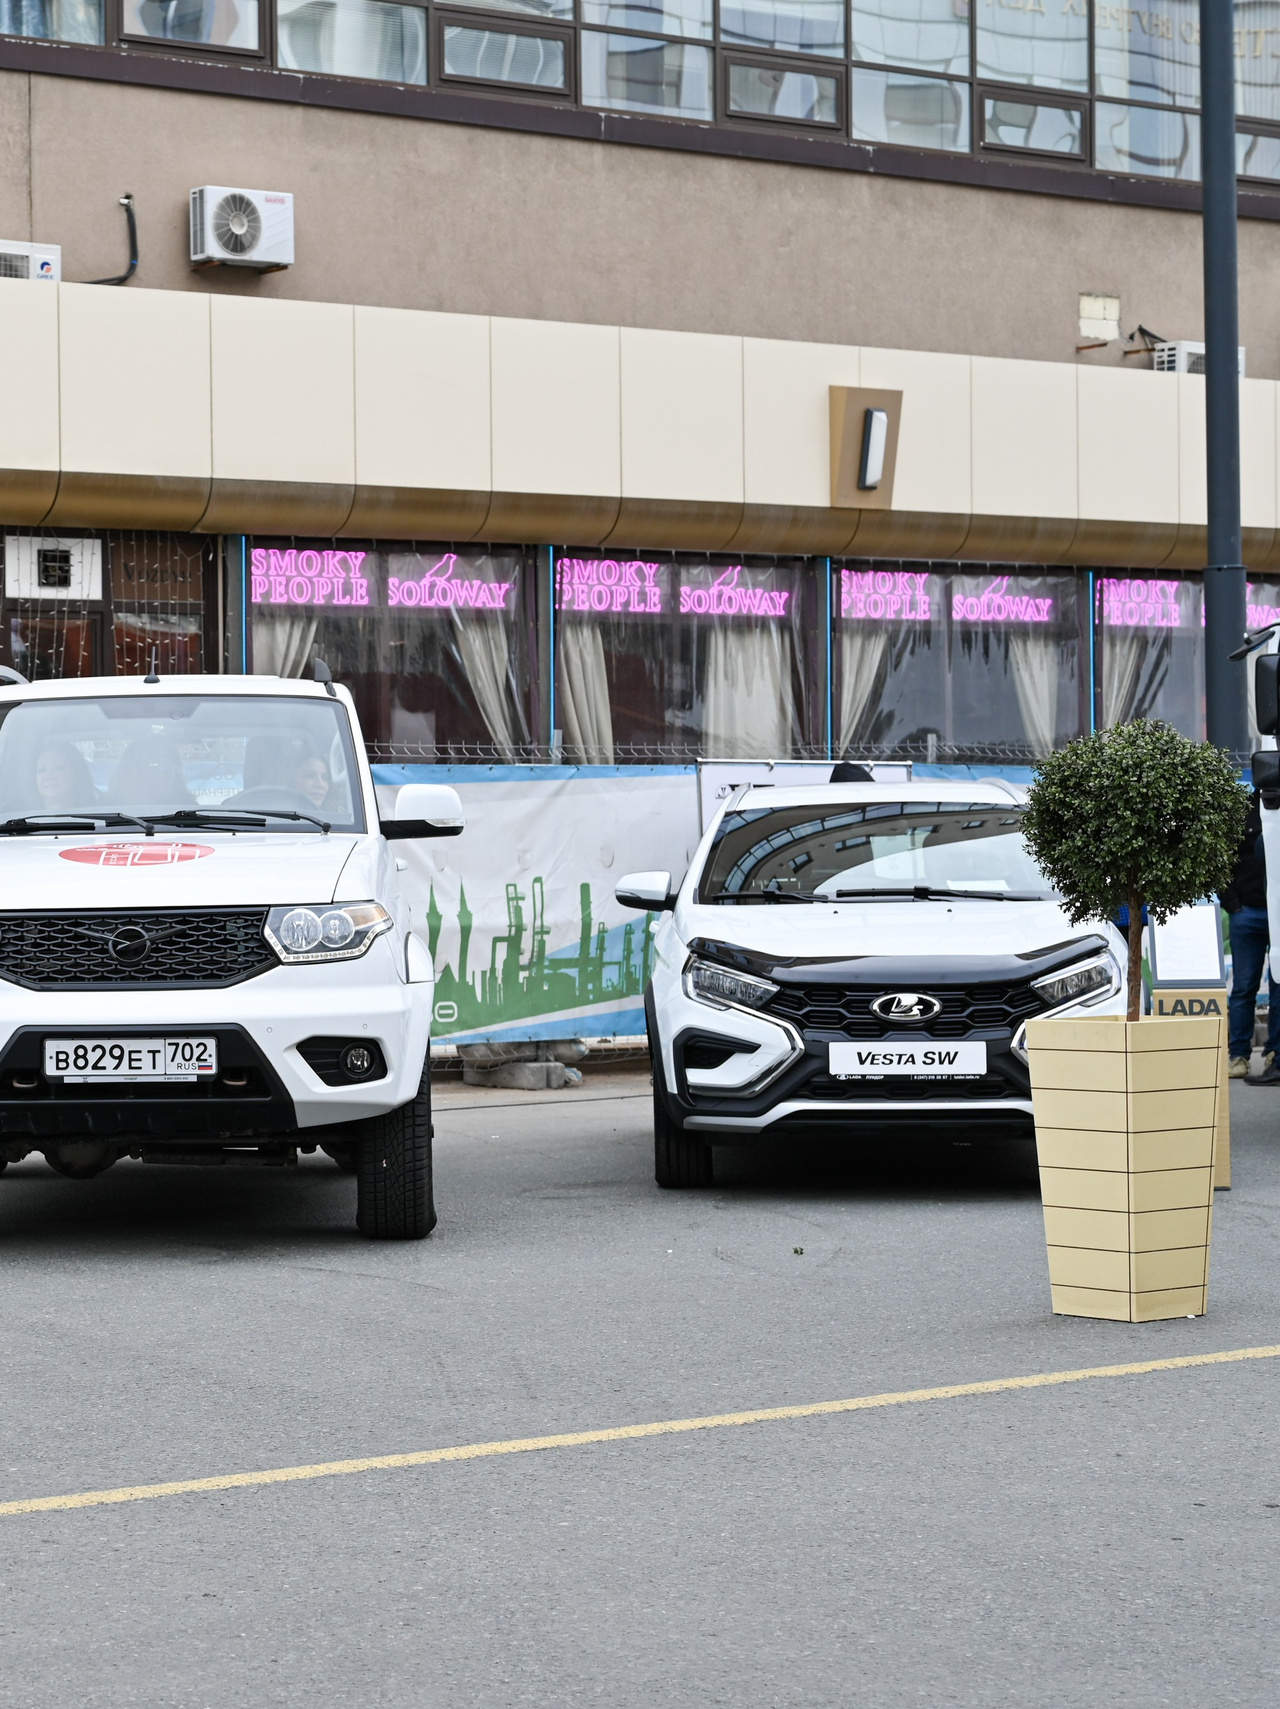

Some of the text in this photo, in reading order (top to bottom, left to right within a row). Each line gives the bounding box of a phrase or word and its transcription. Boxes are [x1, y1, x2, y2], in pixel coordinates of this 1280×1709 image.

[251, 549, 367, 577] SMOKY
[556, 558, 660, 587] SMOKY
[251, 576, 369, 605] PEOPLE
[388, 578, 509, 608] SOLOWAY
[841, 569, 929, 595] SMOKY
[555, 583, 662, 613] PEOPLE
[680, 585, 789, 615] SOLOWAY
[841, 594, 931, 620] PEOPLE
[952, 594, 1052, 621] SOLOWAY
[1158, 999, 1222, 1016] LADA
[55, 1042, 208, 1071] В829ЕТ 702
[177, 1062, 197, 1070] RUS
[856, 1051, 959, 1066] VESTA SW
